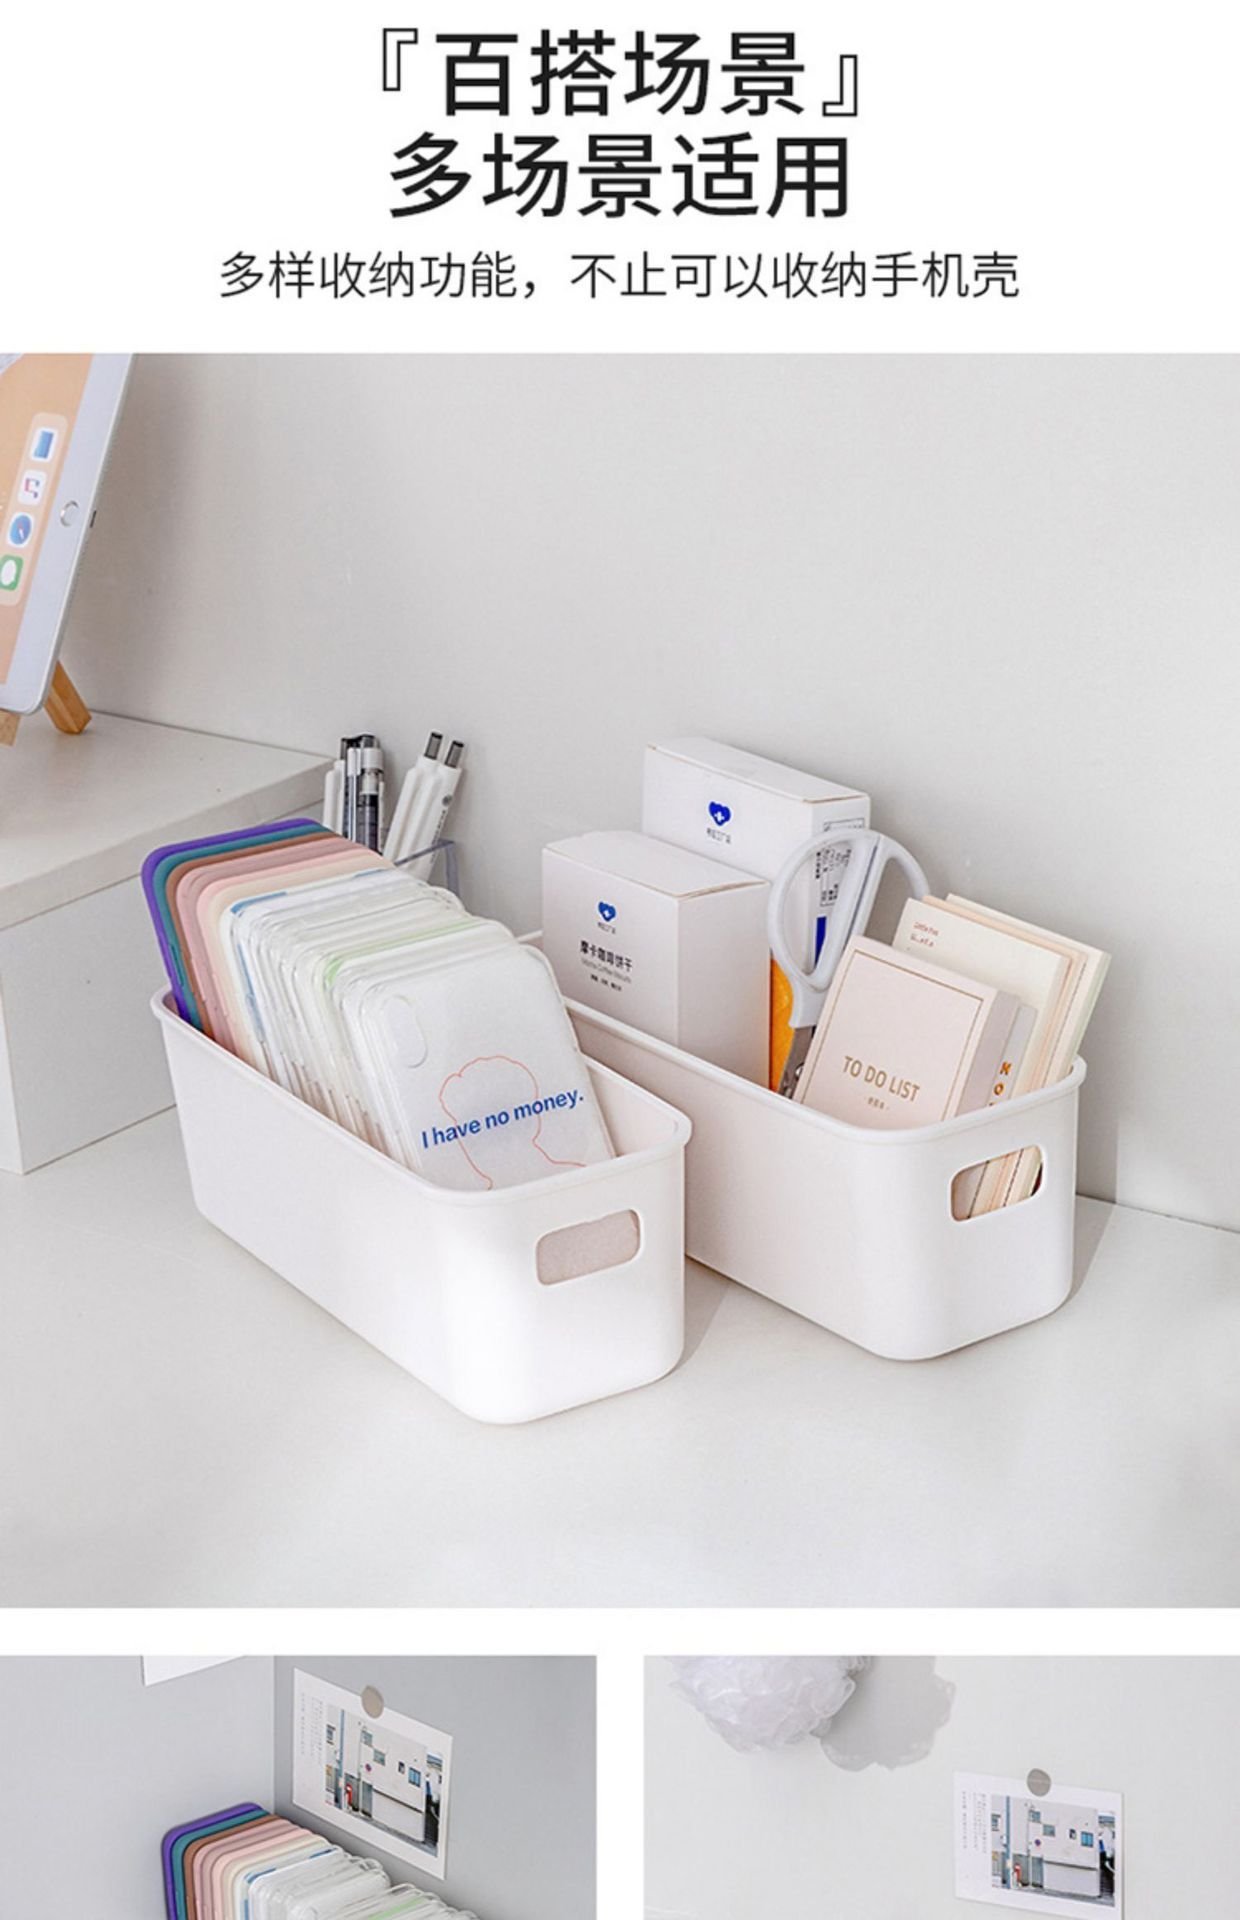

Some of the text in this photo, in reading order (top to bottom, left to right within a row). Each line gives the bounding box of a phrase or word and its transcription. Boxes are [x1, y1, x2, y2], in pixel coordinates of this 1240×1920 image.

[843, 1055, 920, 1102] TO DO LIST
[422, 1089, 585, 1149] I have no money.
